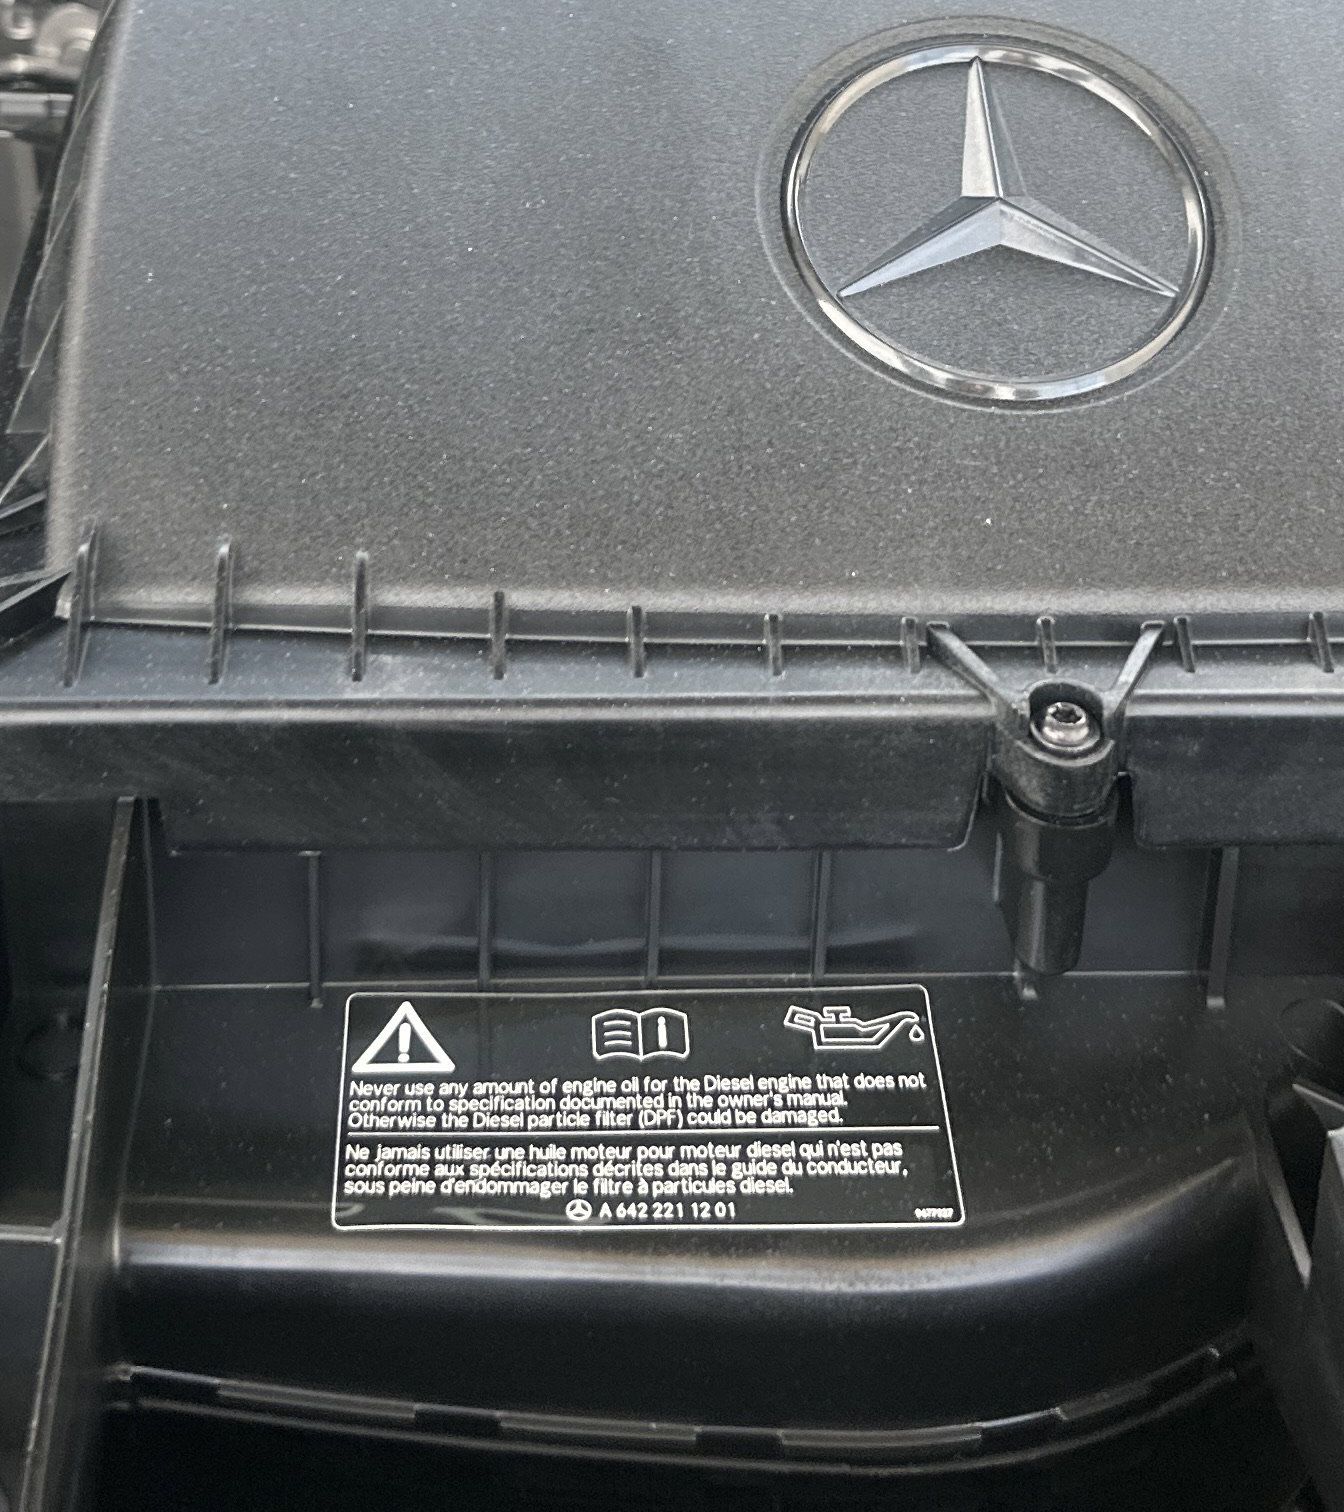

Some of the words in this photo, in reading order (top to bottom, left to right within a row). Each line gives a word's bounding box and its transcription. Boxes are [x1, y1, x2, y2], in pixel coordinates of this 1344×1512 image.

[349, 1080, 399, 1096] Never
[404, 1083, 434, 1095] use
[439, 1082, 466, 1098] any
[473, 1081, 535, 1095] amount
[539, 1078, 558, 1094] of
[562, 1078, 615, 1096] engine
[621, 1077, 638, 1093] oil
[644, 1076, 668, 1092] for
[673, 1076, 700, 1091] the
[704, 1074, 754, 1091] Diesel
[758, 1073, 812, 1093] engine
[816, 1073, 849, 1089] that
[854, 1073, 895, 1088] does
[898, 1072, 927, 1088] not
[349, 1097, 421, 1112] conform
[426, 1097, 444, 1111] to
[449, 1095, 555, 1114] specification
[560, 1094, 664, 1110] documented
[668, 1092, 682, 1108] in
[686, 1092, 713, 1108] the
[717, 1091, 783, 1107] owner's
[787, 1090, 848, 1106] manual.
[348, 1111, 436, 1128] Otherwise
[441, 1112, 469, 1127] the
[473, 1112, 523, 1128] Diesel
[528, 1111, 590, 1129] particle
[595, 1110, 632, 1126] filter
[638, 1110, 683, 1128] (DPF)
[687, 1109, 731, 1124] could
[735, 1108, 756, 1123] be
[761, 1107, 843, 1126] damaged.
[345, 1144, 370, 1160] Ne
[375, 1144, 430, 1162] jamais
[435, 1143, 490, 1160] utiliser
[494, 1146, 525, 1159] une
[529, 1143, 566, 1159] huile
[570, 1144, 632, 1159] moteur
[637, 1144, 675, 1162] pour
[680, 1142, 741, 1158] moteur
[746, 1140, 794, 1157] diesel
[799, 1140, 823, 1159] qui
[828, 1140, 867, 1156] n'est
[872, 1142, 902, 1158] pas
[345, 1161, 430, 1177] conforme
[434, 1164, 464, 1176] aux
[469, 1161, 588, 1179] spécifications
[592, 1159, 663, 1176] décrites
[667, 1160, 708, 1175] dans
[712, 1159, 726, 1175] le
[731, 1158, 778, 1179] guide
[782, 1158, 803, 1174] du
[807, 1158, 908, 1177] conducteur,
[344, 1180, 384, 1195] sous
[389, 1179, 436, 1199] peine
[440, 1178, 569, 1199] d'endommager
[573, 1178, 588, 1194] le
[593, 1178, 633, 1194] filtre
[637, 1177, 649, 1194] à
[652, 1178, 736, 1197] particules
[740, 1177, 794, 1194] diesel.
[599, 1202, 612, 1218] A
[616, 1202, 648, 1218] 642
[652, 1202, 684, 1218] 221
[691, 1202, 711, 1218] 12
[715, 1202, 735, 1218] 01
